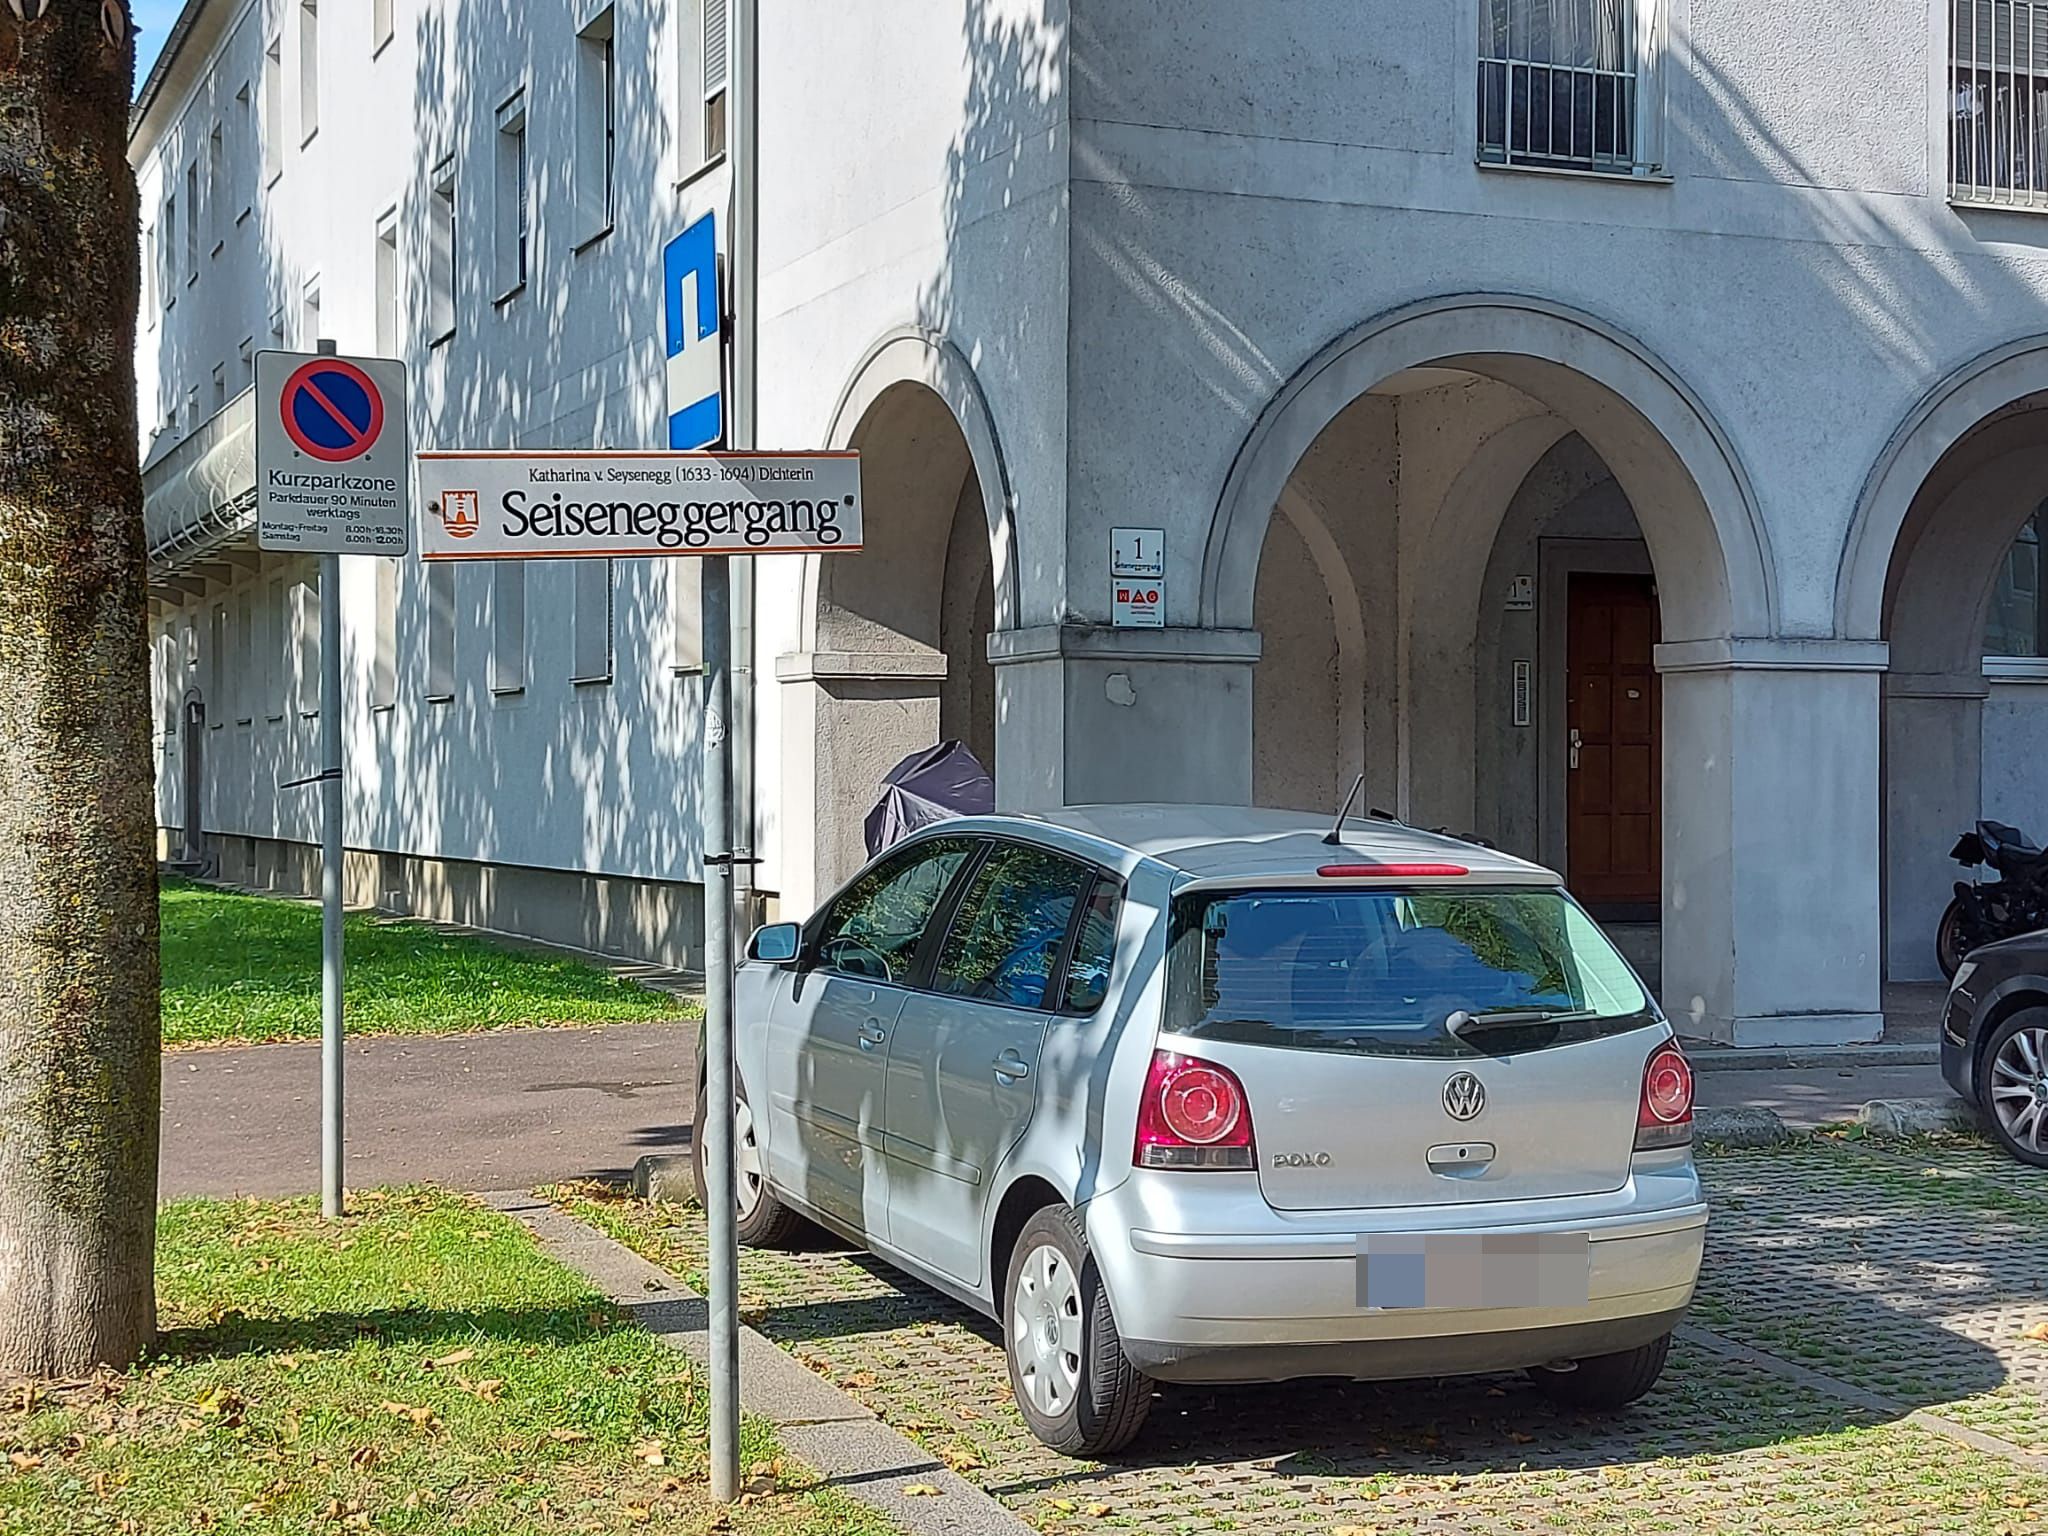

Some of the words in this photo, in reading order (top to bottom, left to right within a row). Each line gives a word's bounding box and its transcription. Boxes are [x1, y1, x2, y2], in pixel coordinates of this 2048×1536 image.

[269, 469, 397, 492] Kurzparkzone
[529, 467, 590, 482] Katharina
[607, 467, 672, 485] Seysenegg
[759, 466, 813, 481] Dichterin
[269, 491, 329, 505] Parkdauer
[331, 495, 347, 506] 90
[350, 496, 397, 508] Minuten
[306, 508, 361, 520] werktags
[502, 490, 843, 548] Seiseneggergang
[262, 531, 301, 542] Samstag
[1134, 536, 1143, 560] 1
[1273, 1152, 1333, 1168] POLO
